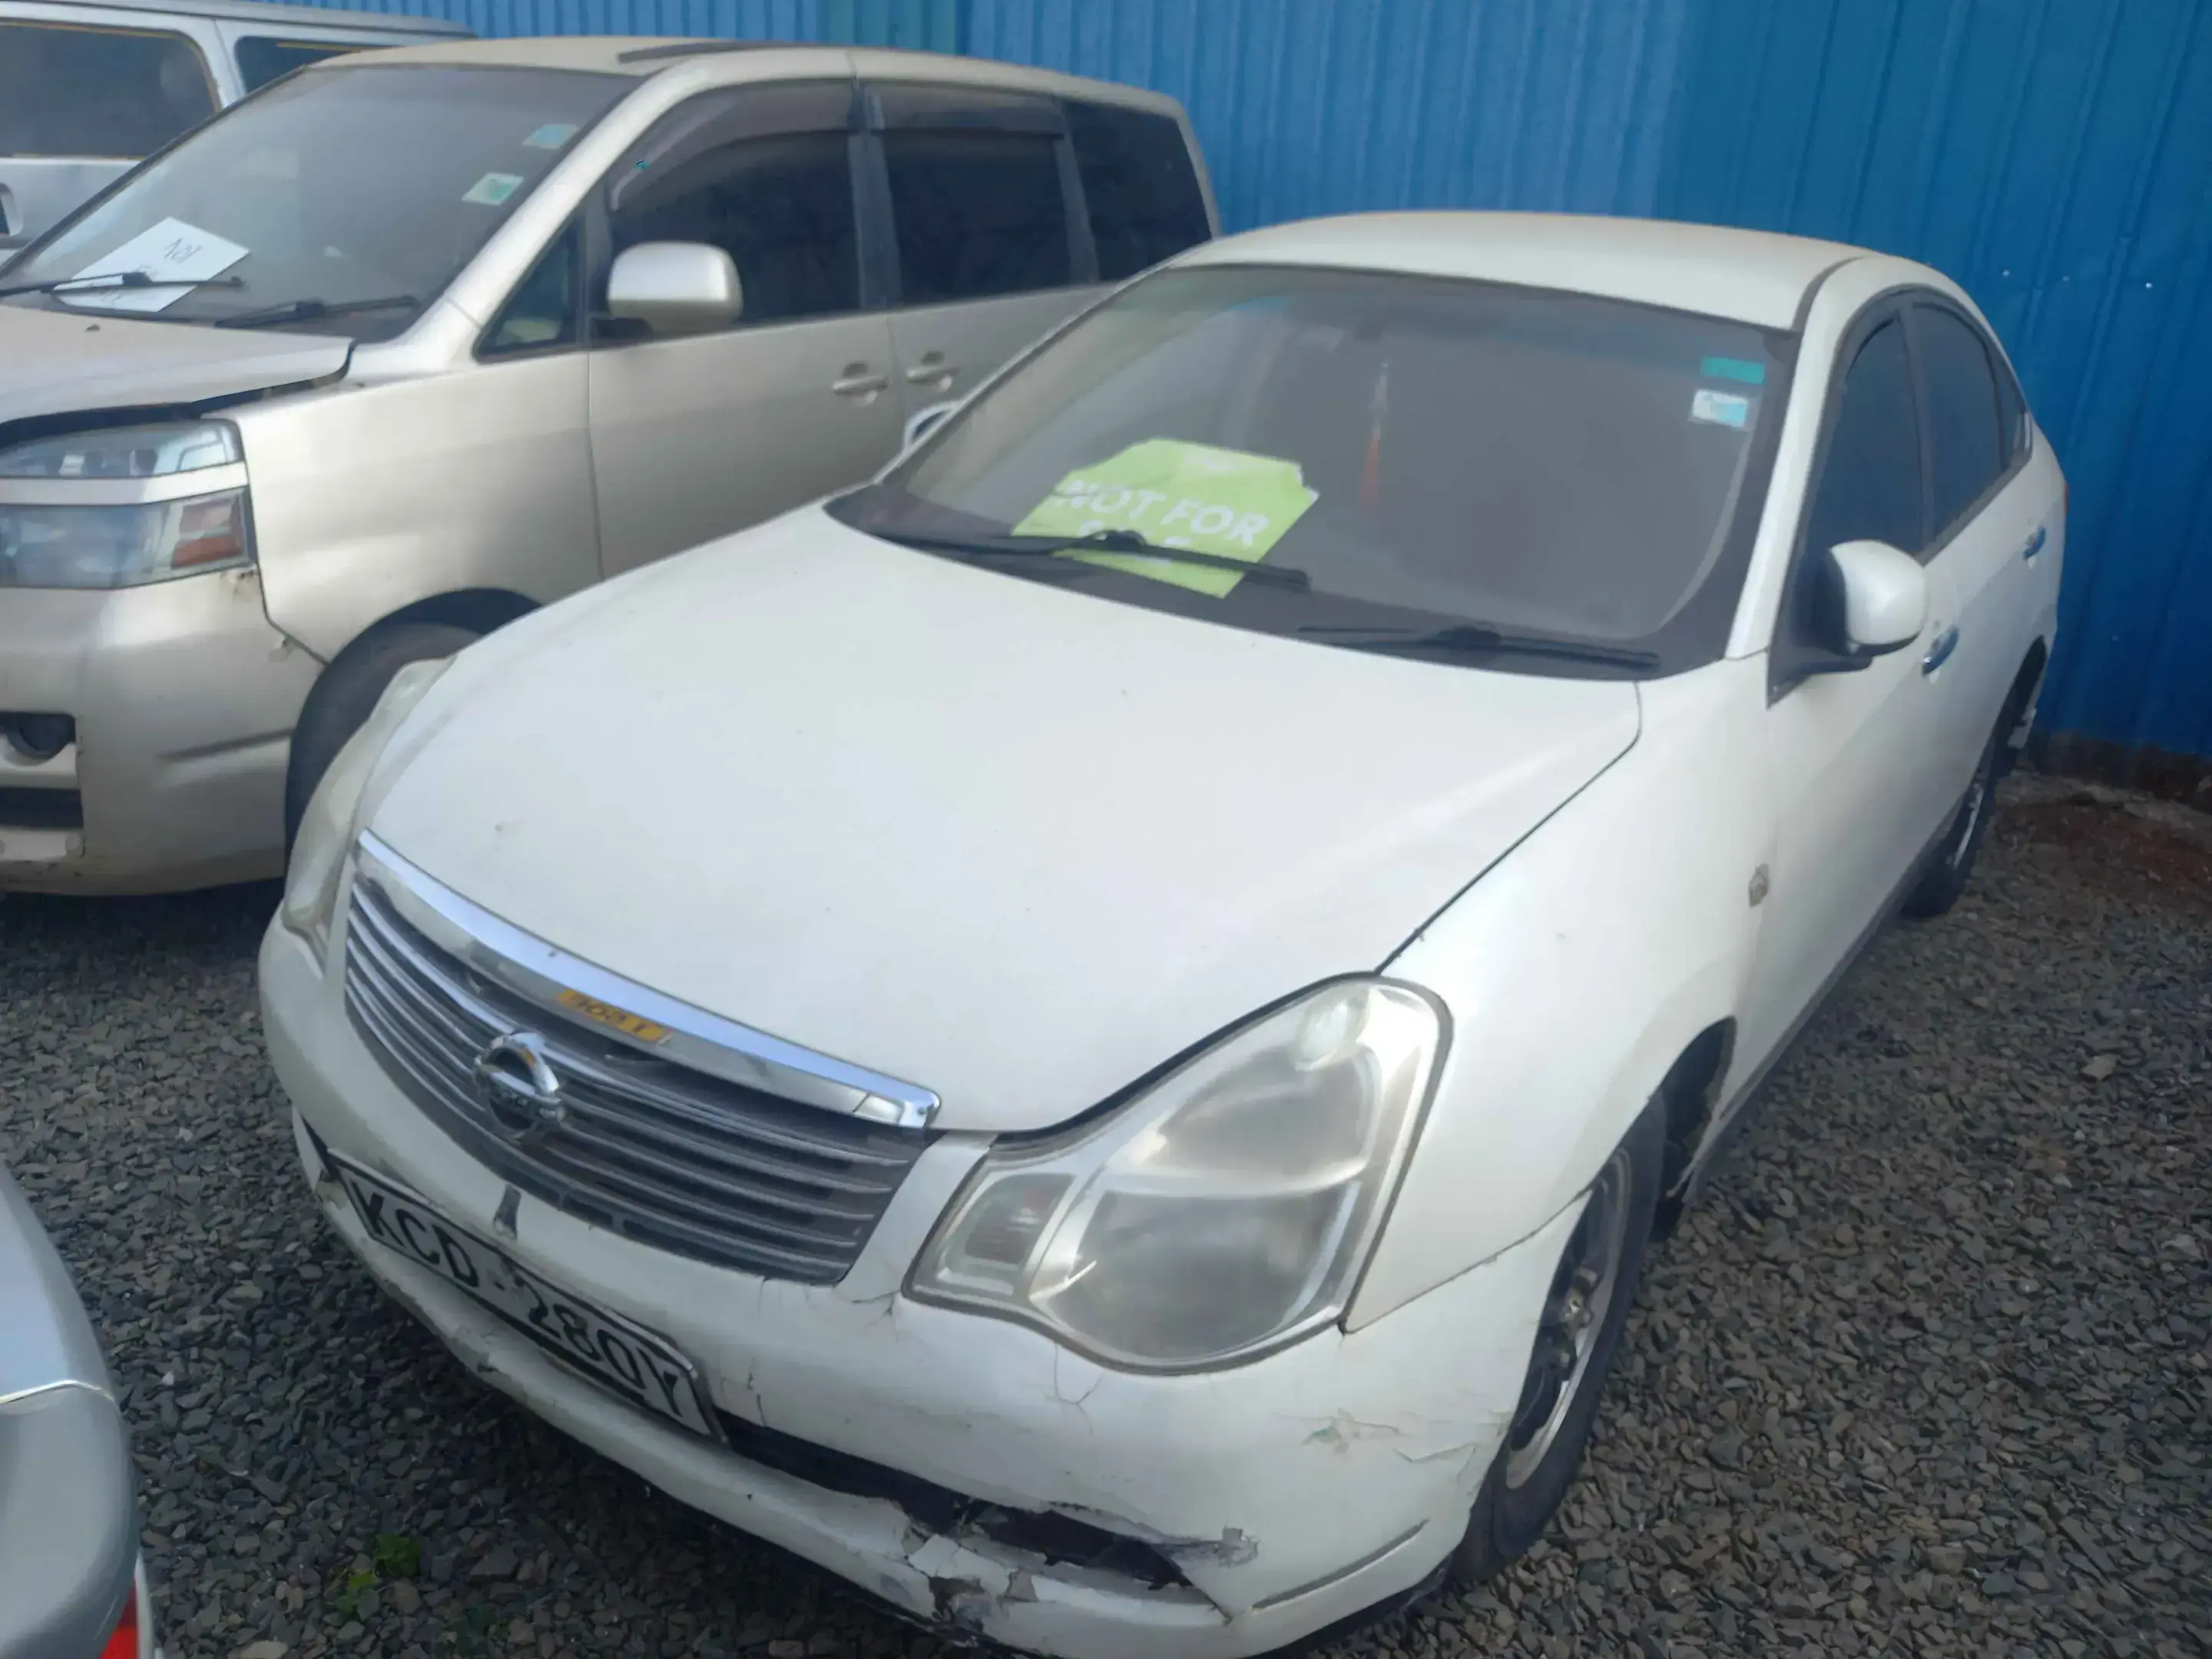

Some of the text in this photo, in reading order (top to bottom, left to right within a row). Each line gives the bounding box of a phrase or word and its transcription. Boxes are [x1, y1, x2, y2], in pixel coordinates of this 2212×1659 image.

[1053, 479, 1167, 521] NOT
[1160, 498, 1271, 547] FOR
[351, 1180, 682, 1418] KCD 280Y
